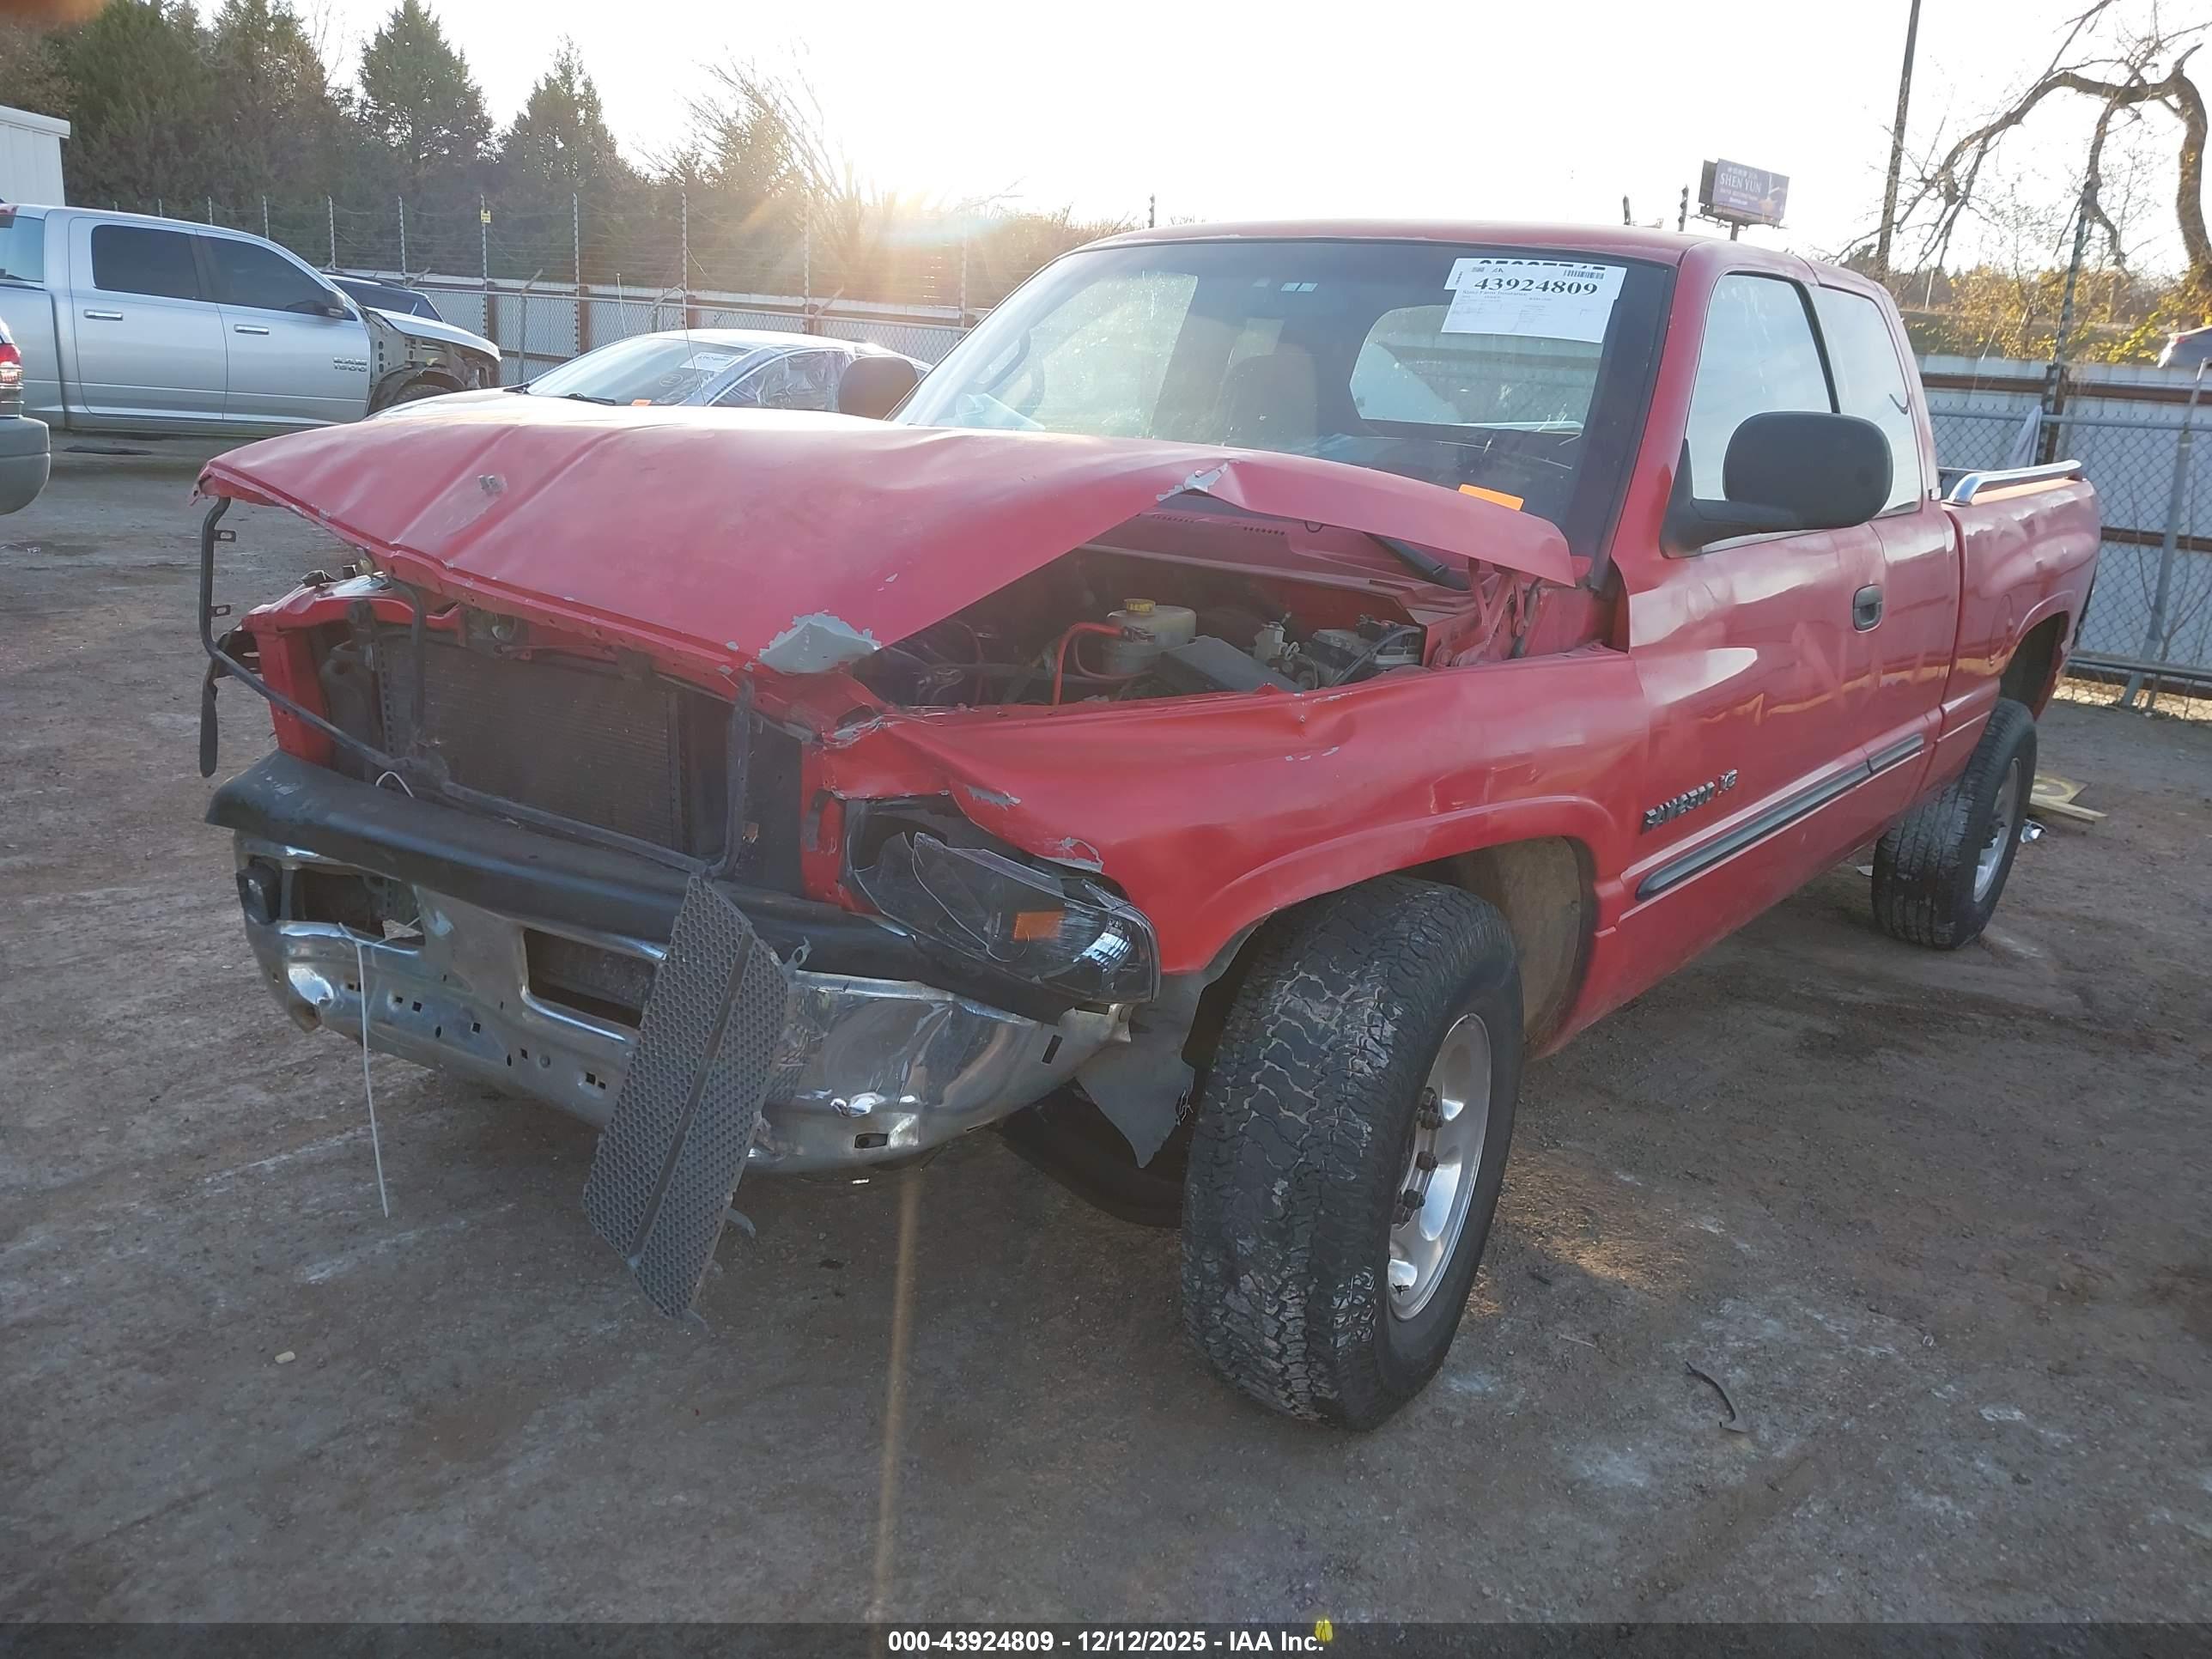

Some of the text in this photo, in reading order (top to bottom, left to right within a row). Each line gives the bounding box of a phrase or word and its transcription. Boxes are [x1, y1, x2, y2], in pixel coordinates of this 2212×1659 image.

[1719, 173, 1743, 189] SHEN
[1744, 179, 1762, 193] YUN
[1474, 276, 1599, 296] 43924809
[333, 363, 368, 373] 1500
